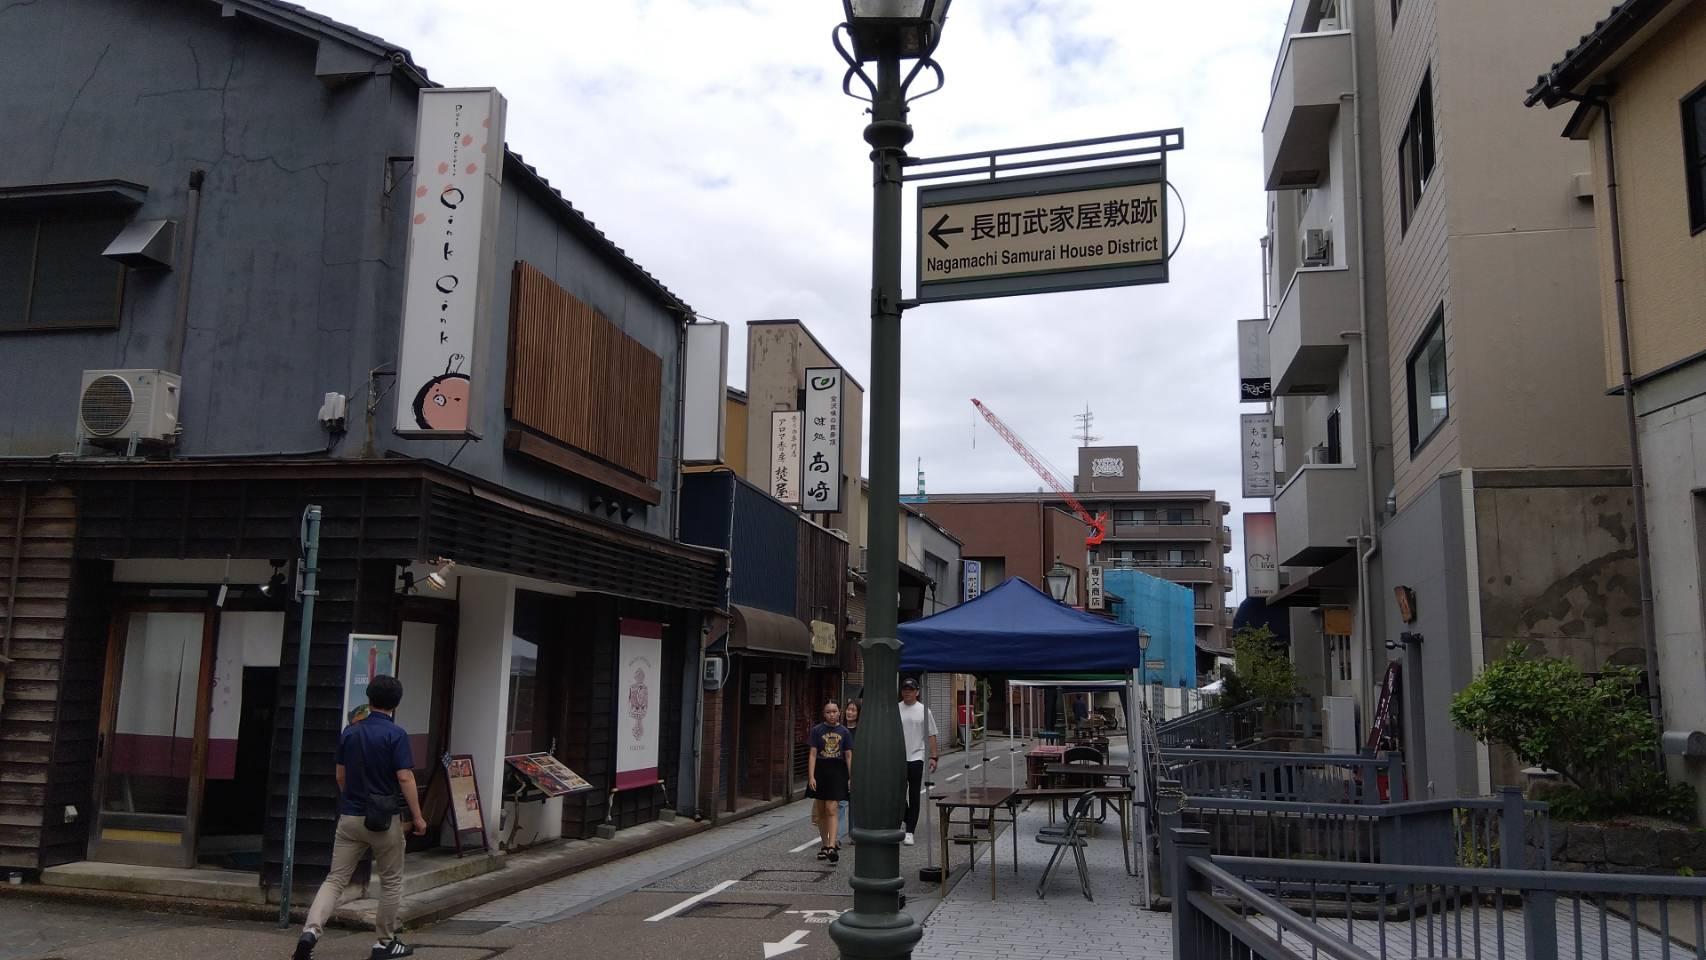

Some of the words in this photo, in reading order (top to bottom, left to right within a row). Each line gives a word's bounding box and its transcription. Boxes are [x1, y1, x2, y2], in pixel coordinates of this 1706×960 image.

[440, 187, 464, 261] Oink
[970, 196, 1158, 241] 長町武家屋敷跡
[927, 250, 998, 273] Nagamachi
[1002, 245, 1056, 265] Samurai
[1060, 238, 1103, 259] House
[1108, 236, 1158, 255] District
[435, 274, 459, 345] Oink
